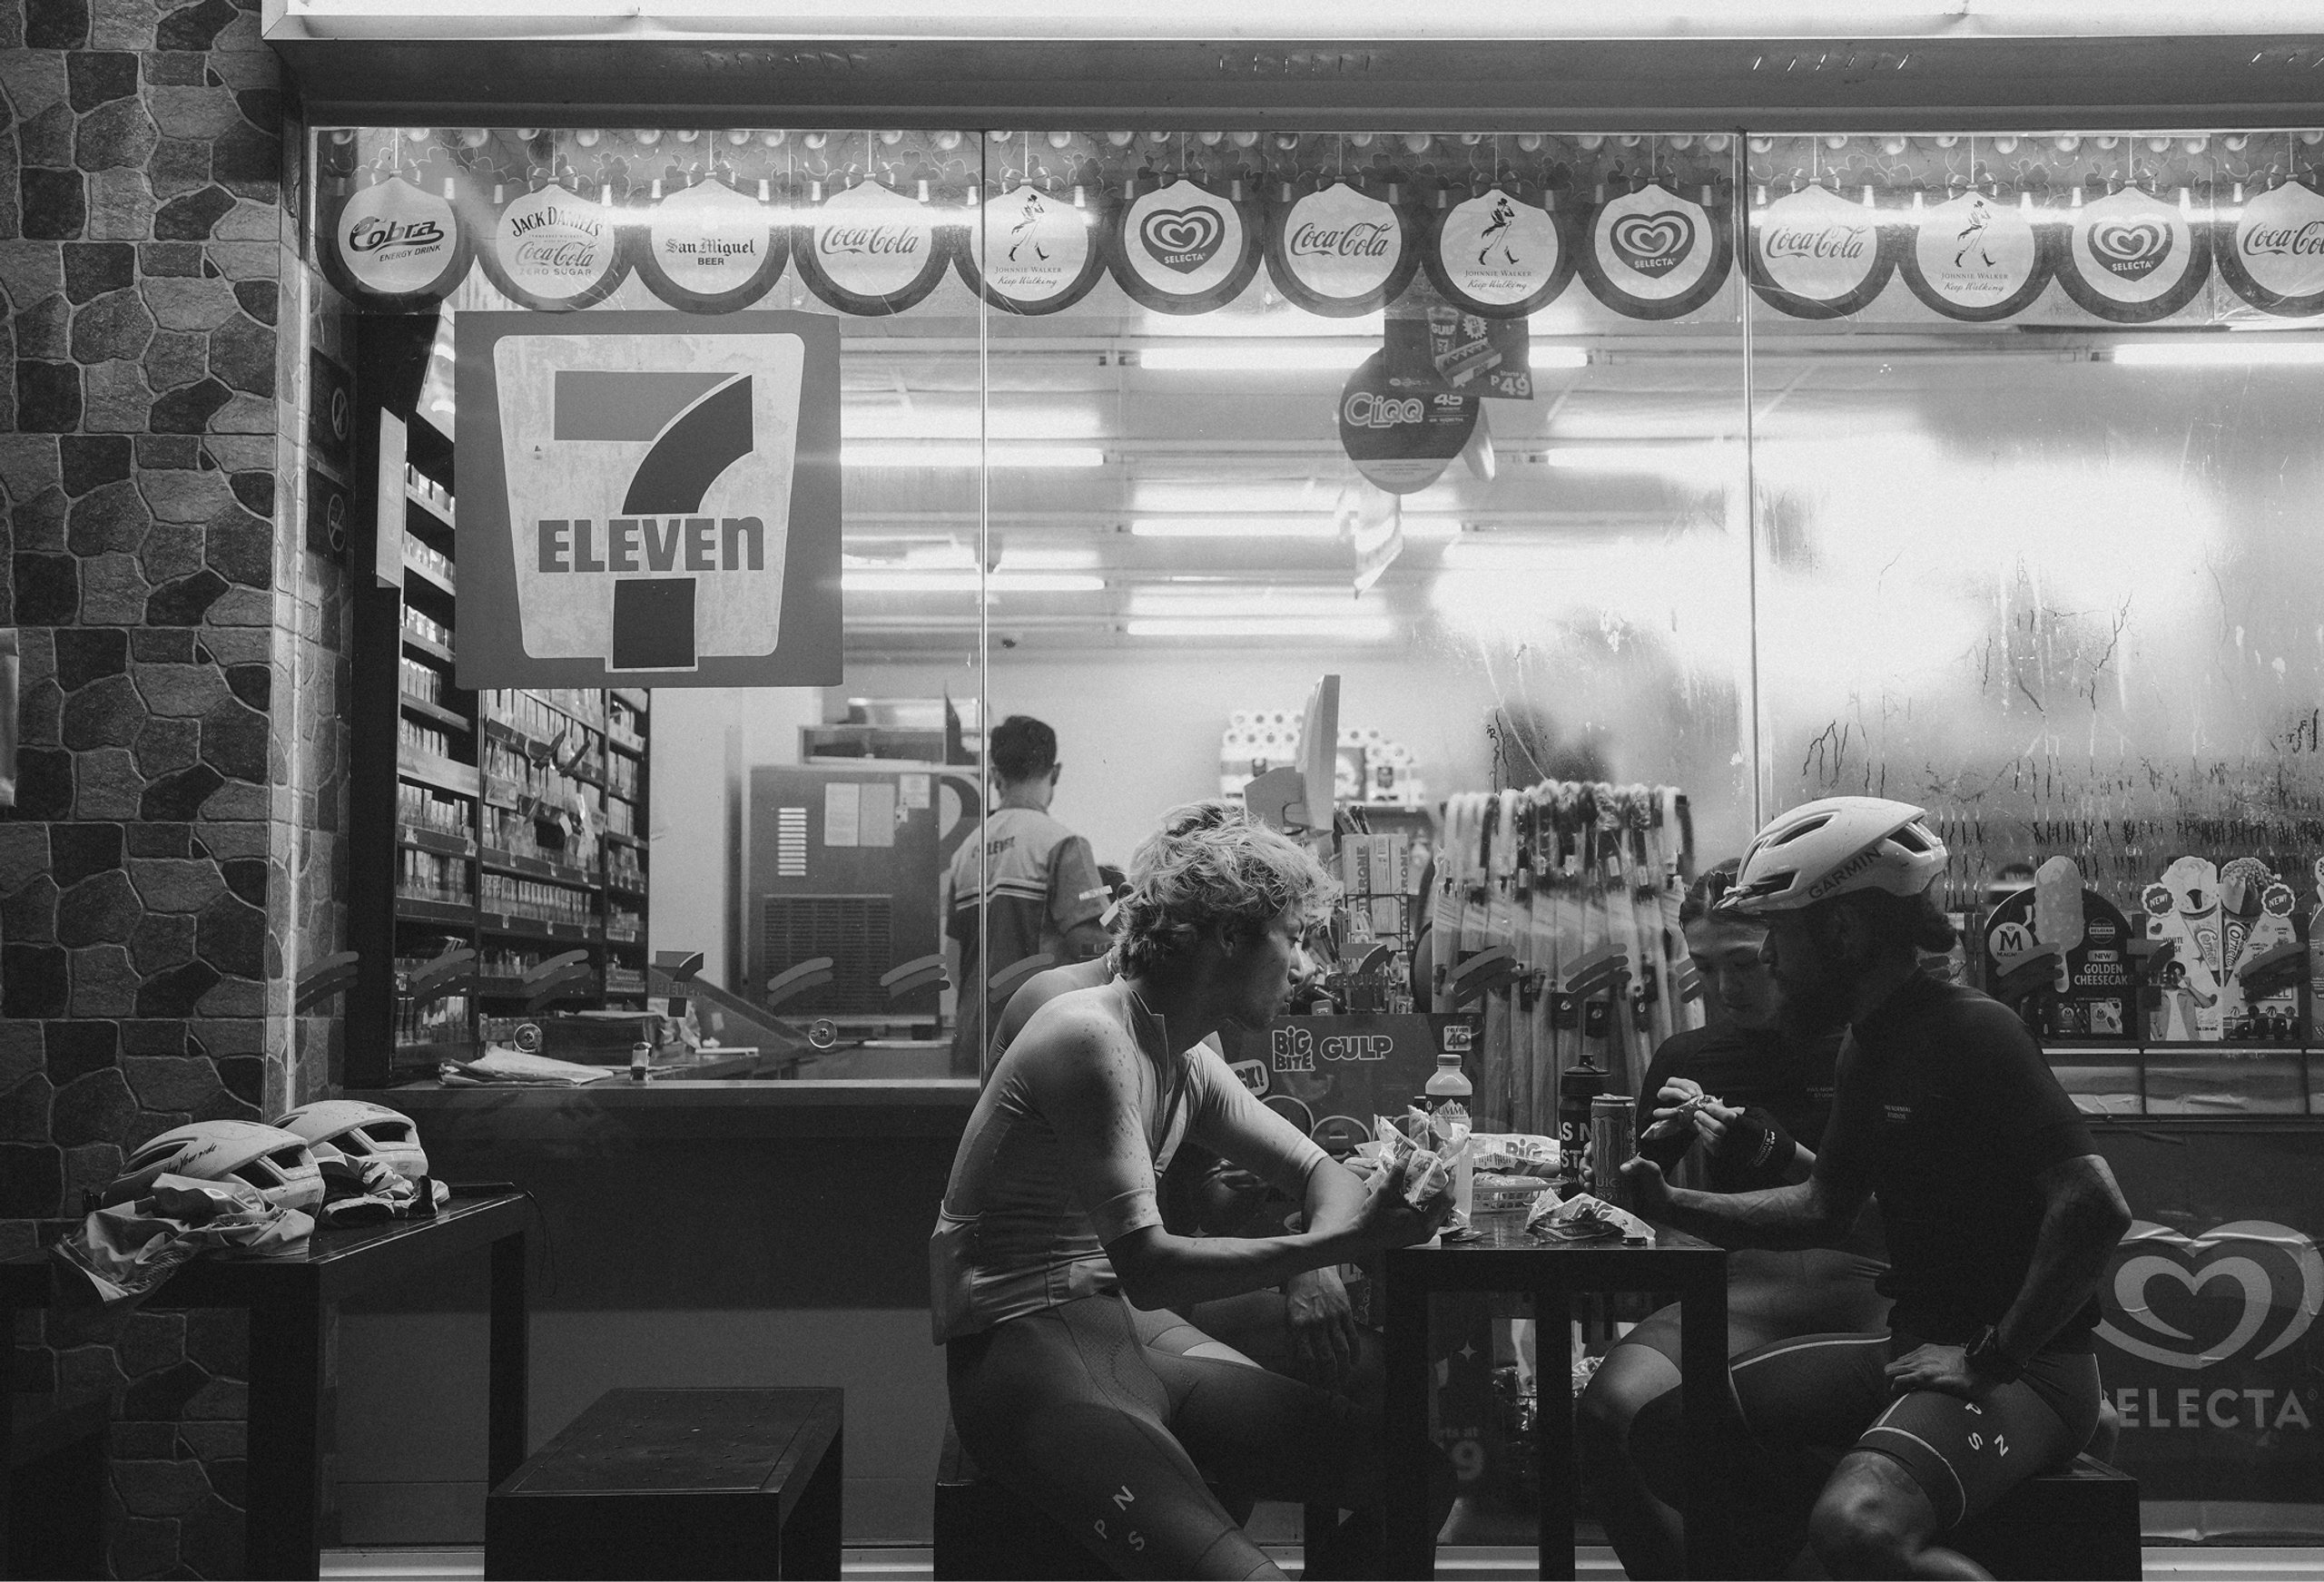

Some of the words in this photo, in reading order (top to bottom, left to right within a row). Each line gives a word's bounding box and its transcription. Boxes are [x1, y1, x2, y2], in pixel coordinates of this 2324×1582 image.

[511, 211, 546, 238] JACK
[350, 216, 444, 252] Cobra
[821, 225, 920, 255] Coca-Cola
[1290, 221, 1395, 257] Coca-Cola
[1766, 225, 1869, 259] Coca-Cola
[379, 249, 413, 261] ENERGY
[414, 243, 441, 256] DRINK
[515, 241, 598, 267] Coca-Cola
[665, 238, 696, 253] San
[698, 238, 756, 257] Miguel
[697, 258, 724, 266] BEER
[1164, 252, 1204, 264] SELECTA
[1634, 258, 1674, 269] SELECTA
[2112, 261, 2152, 271] SELECTA
[519, 268, 549, 276] ZERO
[554, 268, 592, 276] SUGAR
[995, 266, 1028, 274] JOHNNIE
[997, 276, 1018, 287] Keep
[1019, 276, 1058, 288] Walking
[1467, 279, 1488, 290] Keep
[1489, 280, 1528, 291] Walking
[1944, 282, 1964, 293] Keep
[1965, 282, 2004, 295] Walking
[554, 369, 754, 670] 7
[1808, 846, 1883, 899] GARMIN
[1999, 930, 2024, 951] M
[2162, 936, 2183, 944] WHITE
[2084, 964, 2122, 974] GOLDEN
[2074, 975, 2128, 986] CHEESECAK
[1321, 1036, 1393, 1060] GULP
[1273, 1053, 1315, 1072] BITE
[2115, 1388, 2312, 1430] ELECTA
